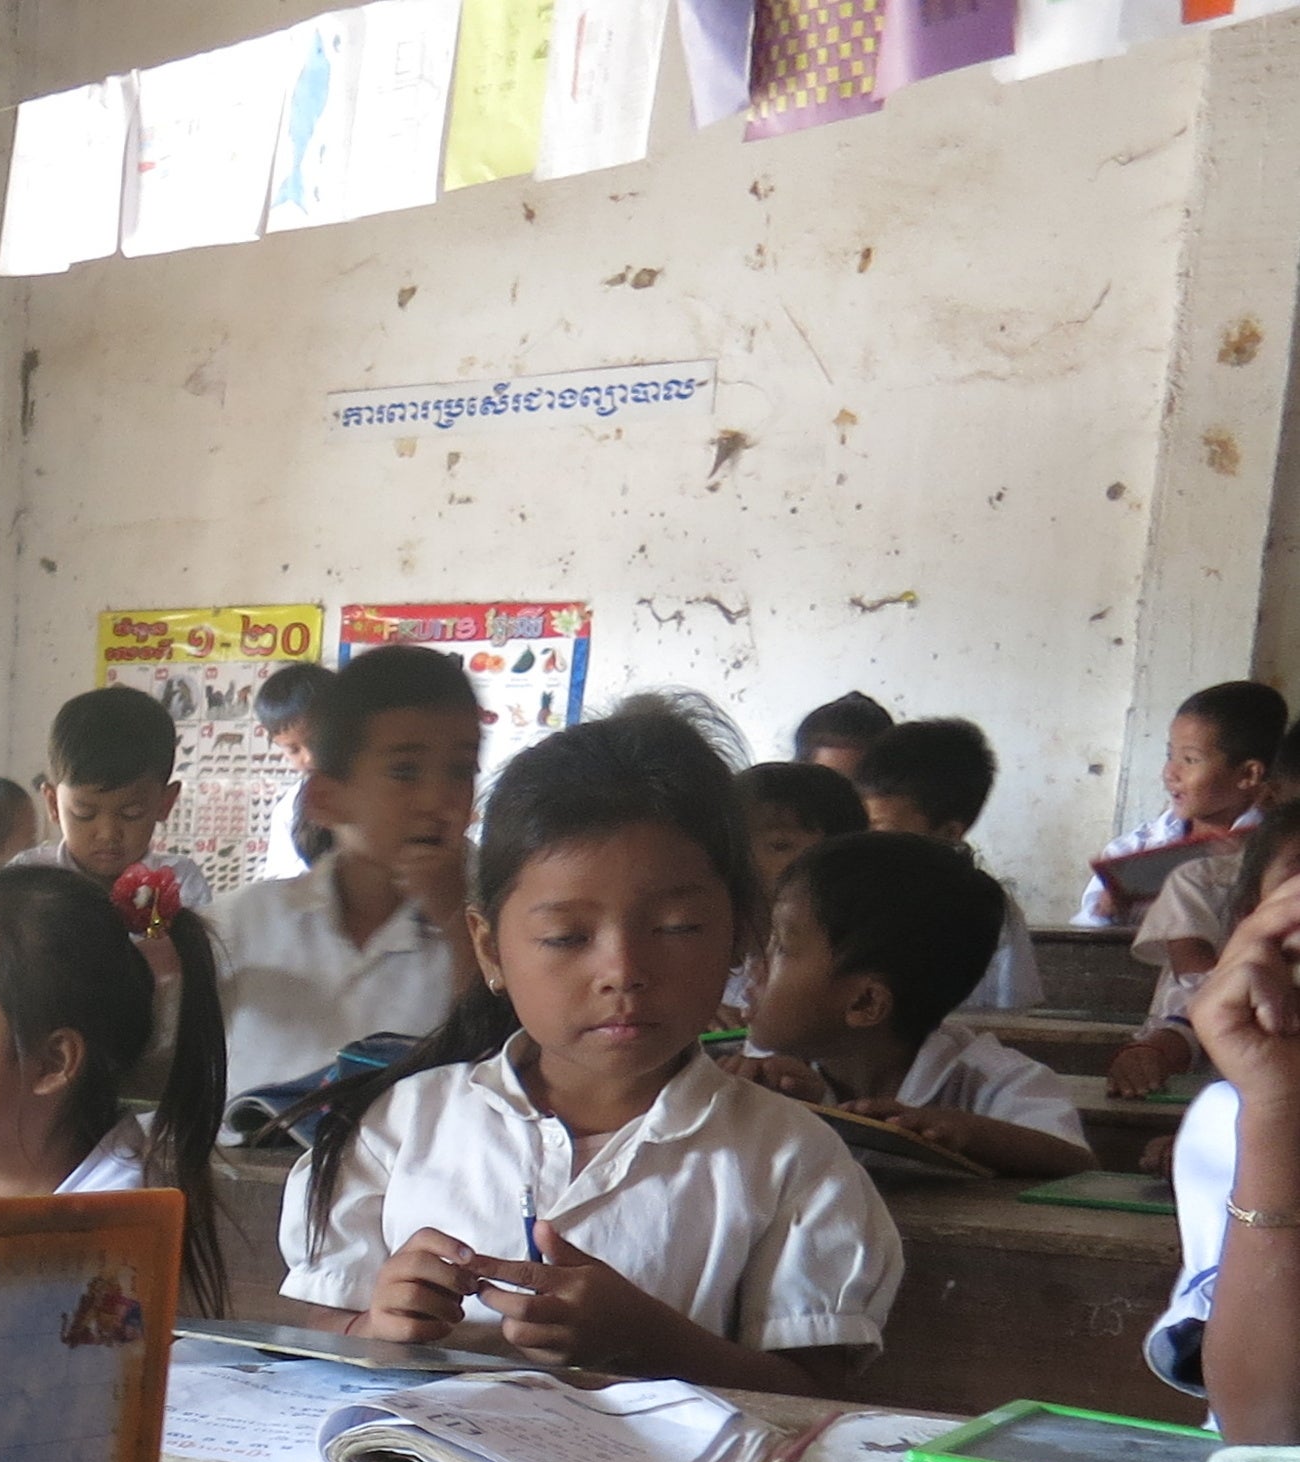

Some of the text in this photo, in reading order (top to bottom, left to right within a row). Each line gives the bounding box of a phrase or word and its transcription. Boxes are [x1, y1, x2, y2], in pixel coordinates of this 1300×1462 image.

[187, 625, 215, 658] ១
[241, 615, 311, 656] ២០
[383, 617, 477, 641] FRUITS
